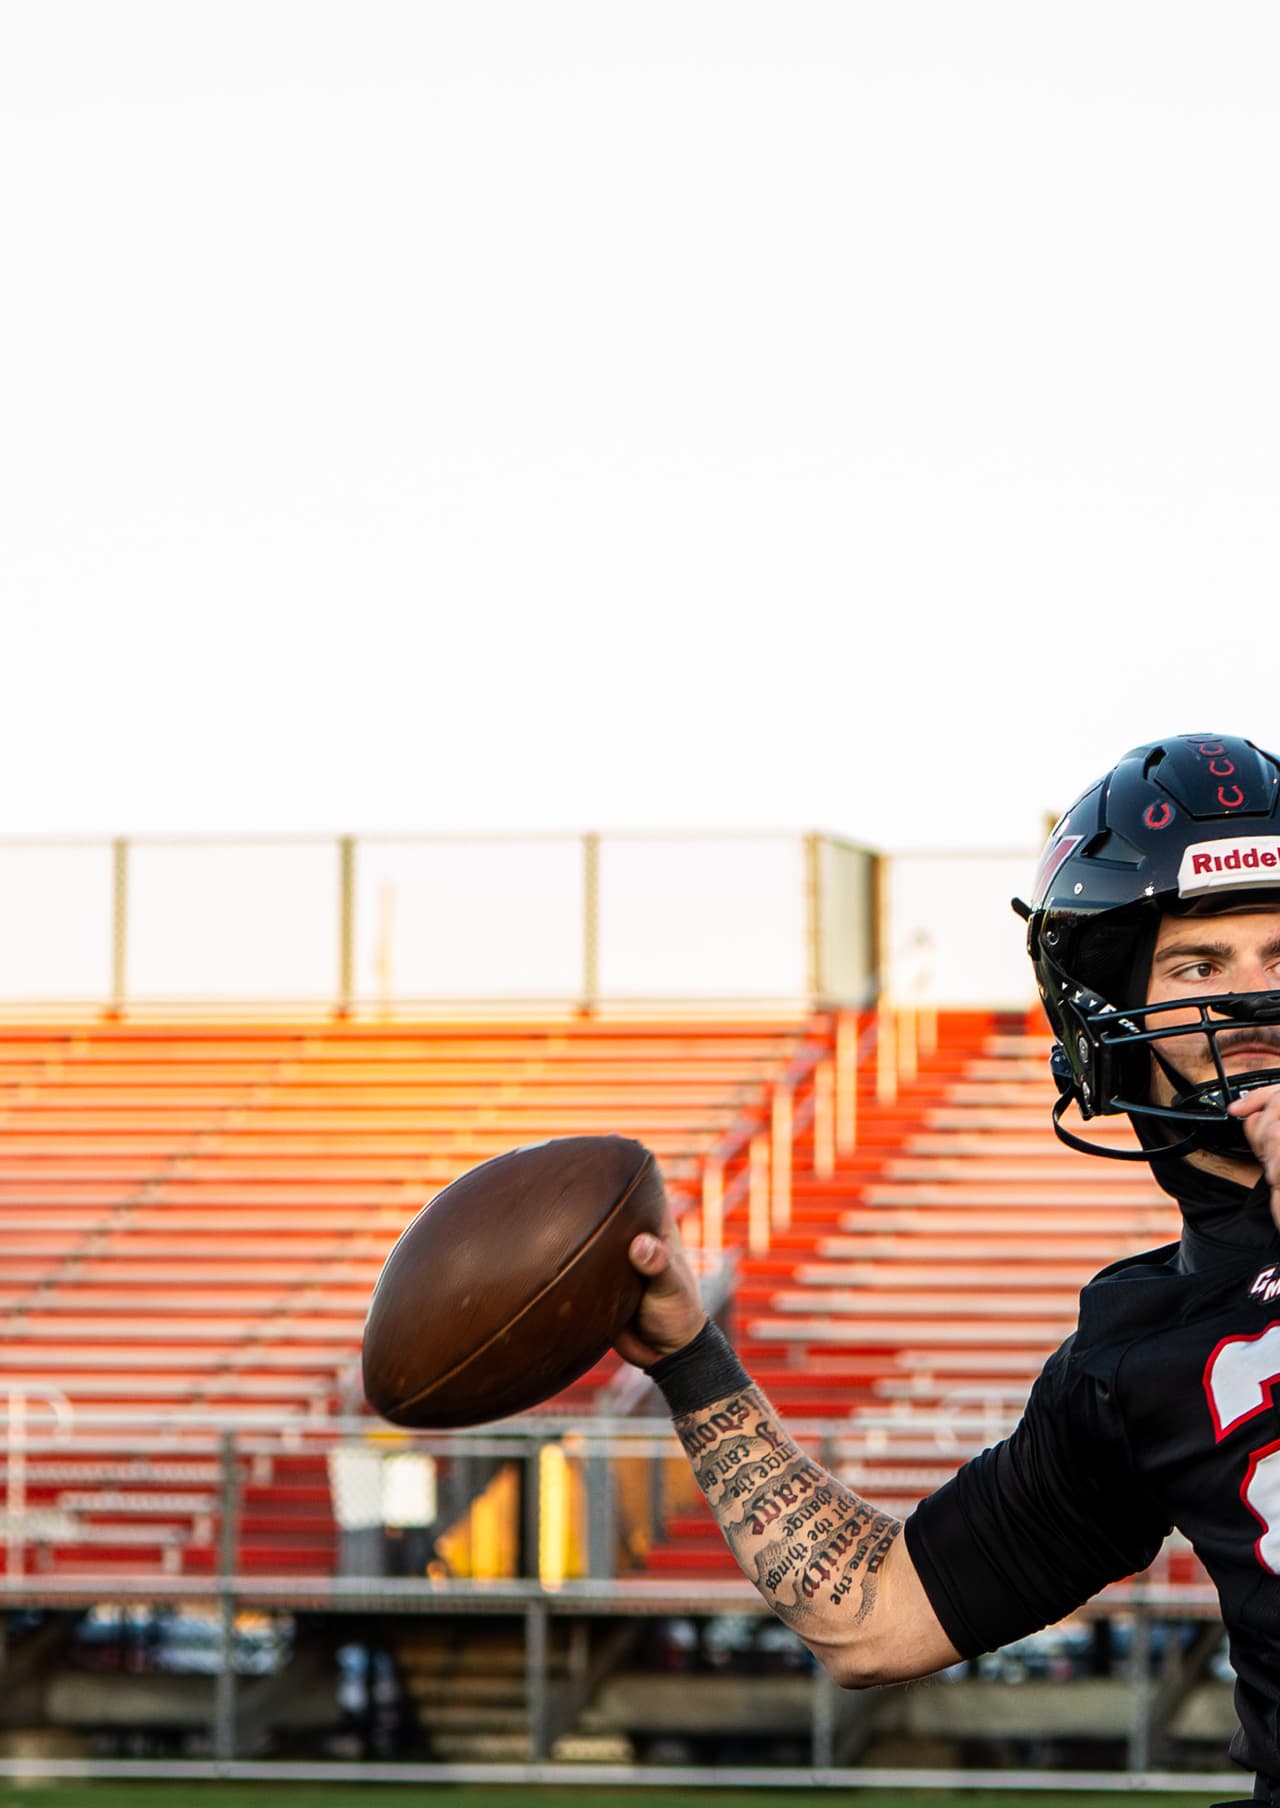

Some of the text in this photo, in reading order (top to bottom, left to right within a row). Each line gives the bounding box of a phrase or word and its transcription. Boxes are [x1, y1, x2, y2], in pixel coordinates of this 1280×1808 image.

[683, 1394, 762, 1459] isdom
[715, 1444, 750, 1475] can
[730, 1474, 755, 1498] the
[745, 1464, 824, 1536] urage
[783, 1488, 833, 1537] change
[807, 1518, 833, 1541] the
[766, 1543, 809, 1595] things
[802, 1507, 873, 1598] renity
[830, 1575, 852, 1605] the
